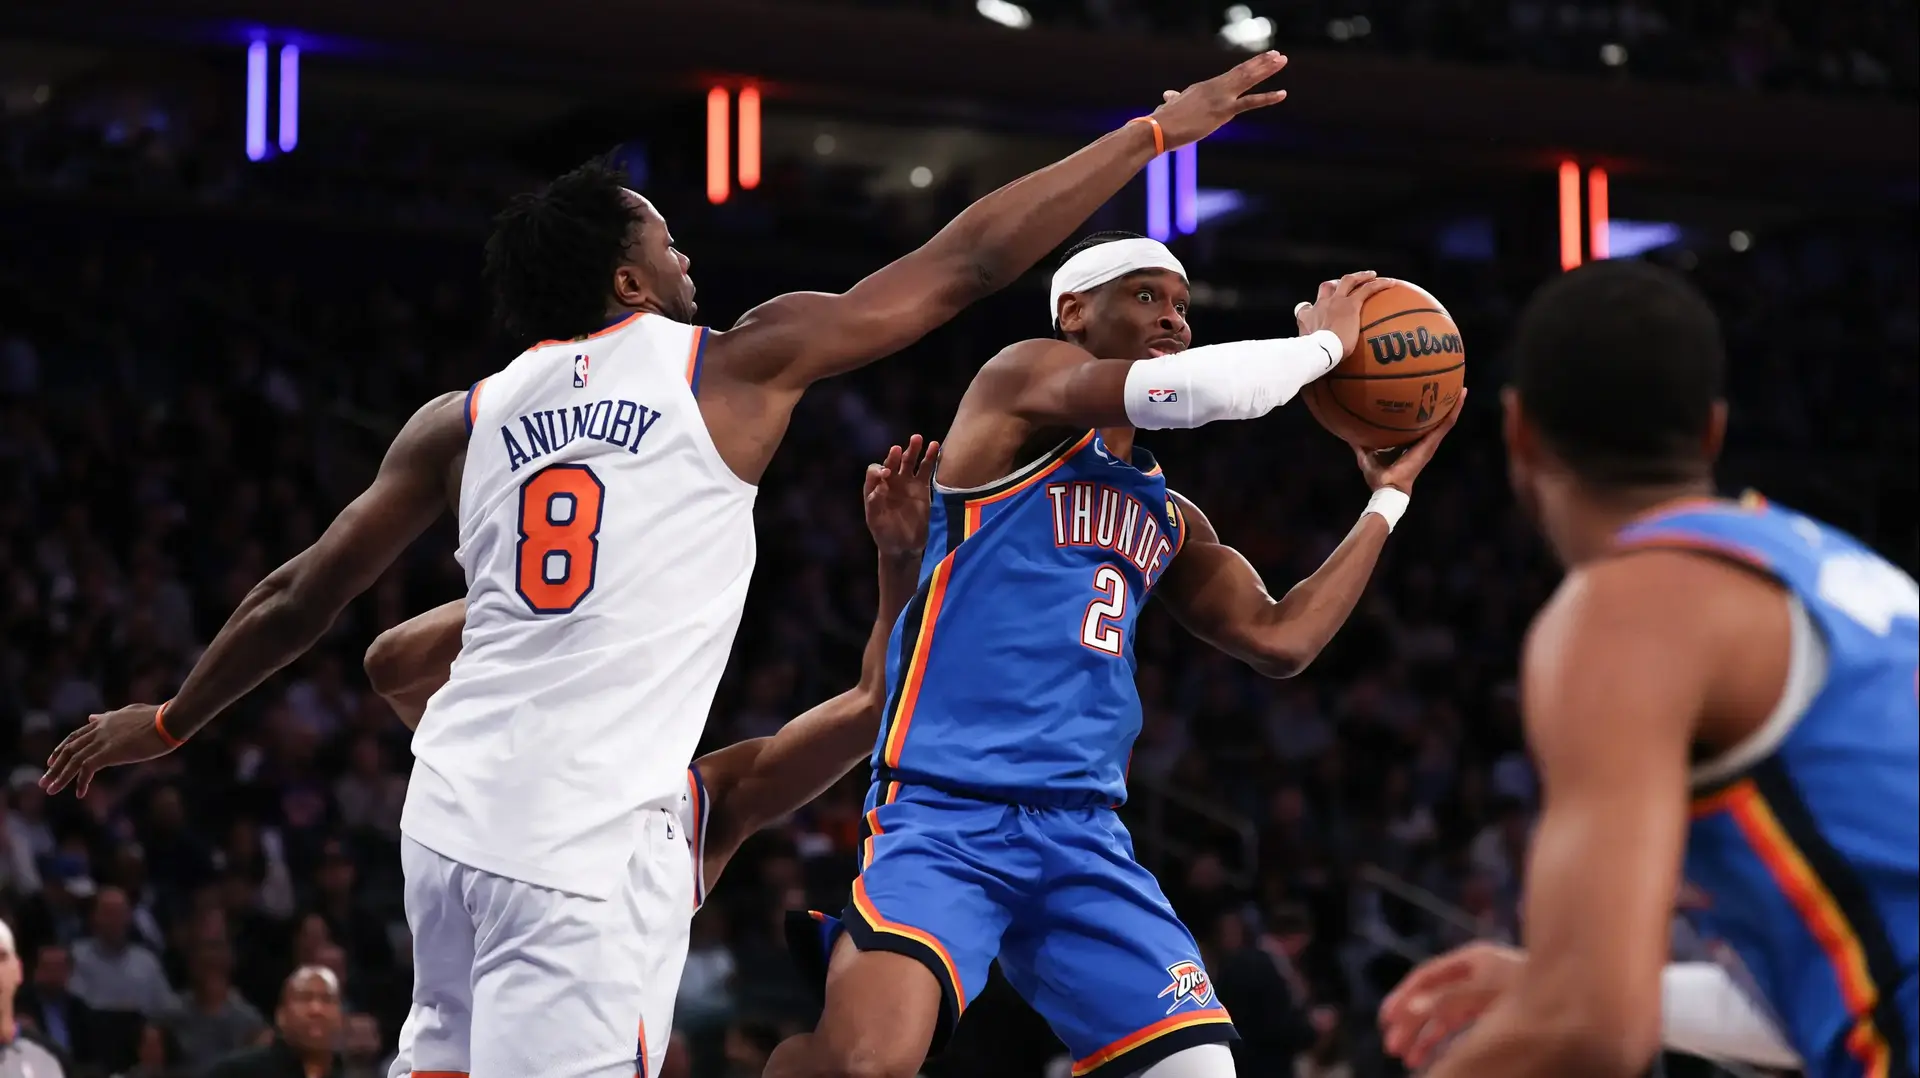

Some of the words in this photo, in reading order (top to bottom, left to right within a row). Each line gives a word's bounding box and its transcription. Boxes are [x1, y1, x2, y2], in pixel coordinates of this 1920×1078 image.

[1367, 325, 1463, 366] Wilson
[500, 399, 662, 472] ANUNOBY
[515, 463, 606, 615] 8
[1080, 563, 1128, 658] 2
[1176, 970, 1205, 998] OKC
